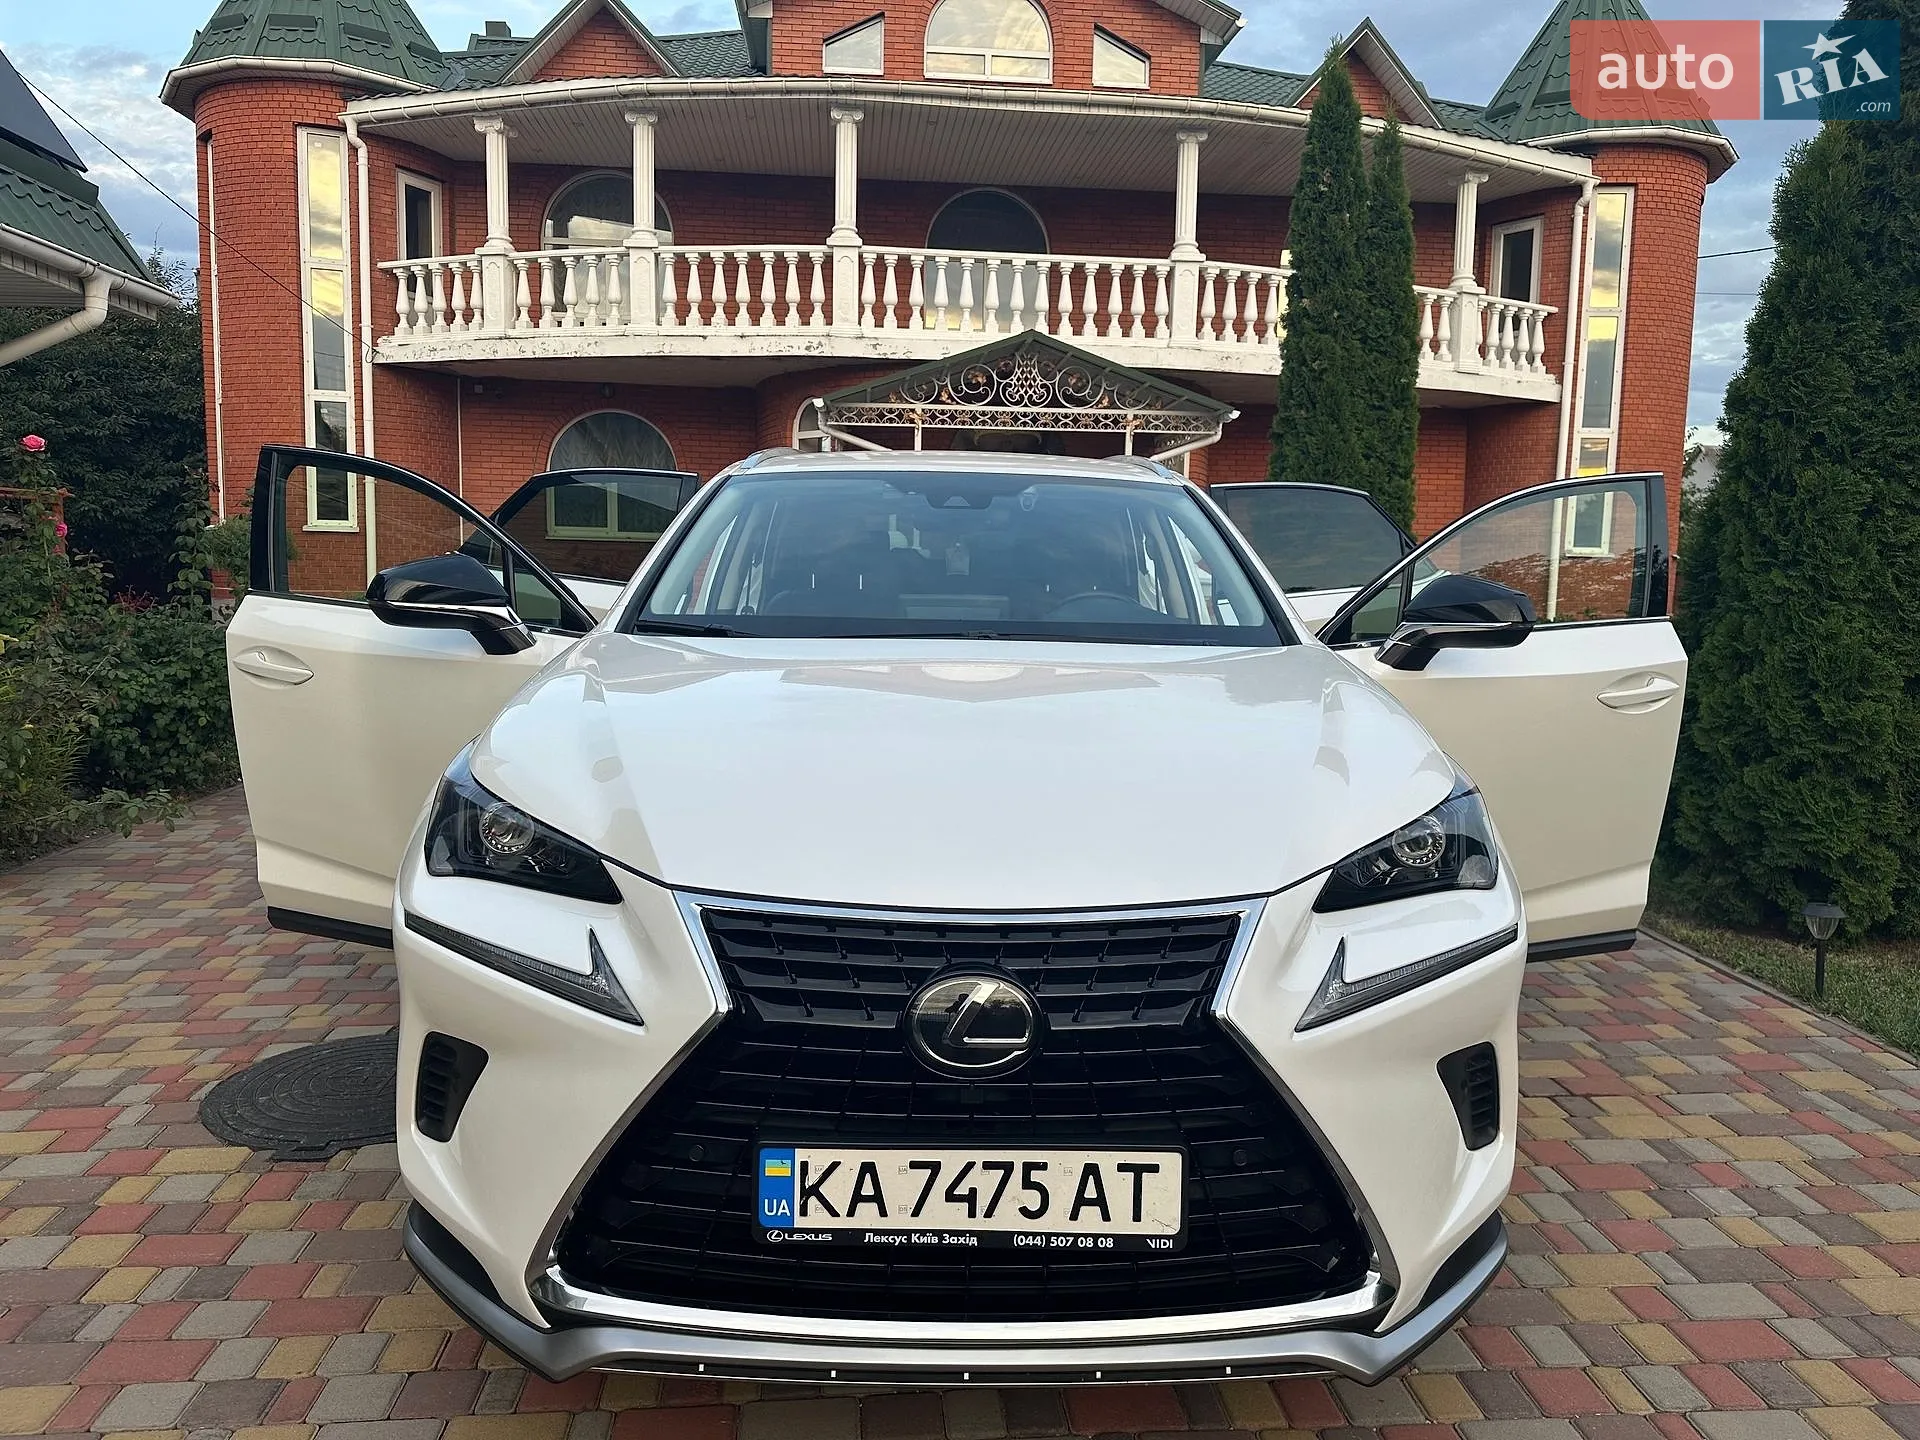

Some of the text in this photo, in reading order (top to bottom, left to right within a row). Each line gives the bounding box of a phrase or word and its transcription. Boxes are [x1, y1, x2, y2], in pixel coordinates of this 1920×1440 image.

[799, 1160, 1160, 1222] KA 7475 AT
[764, 1199, 791, 1217] UA
[785, 1232, 833, 1241] LEXUS
[864, 1232, 978, 1246] Лексус Київ Захід
[1013, 1234, 1114, 1248] (044) 507 08 08
